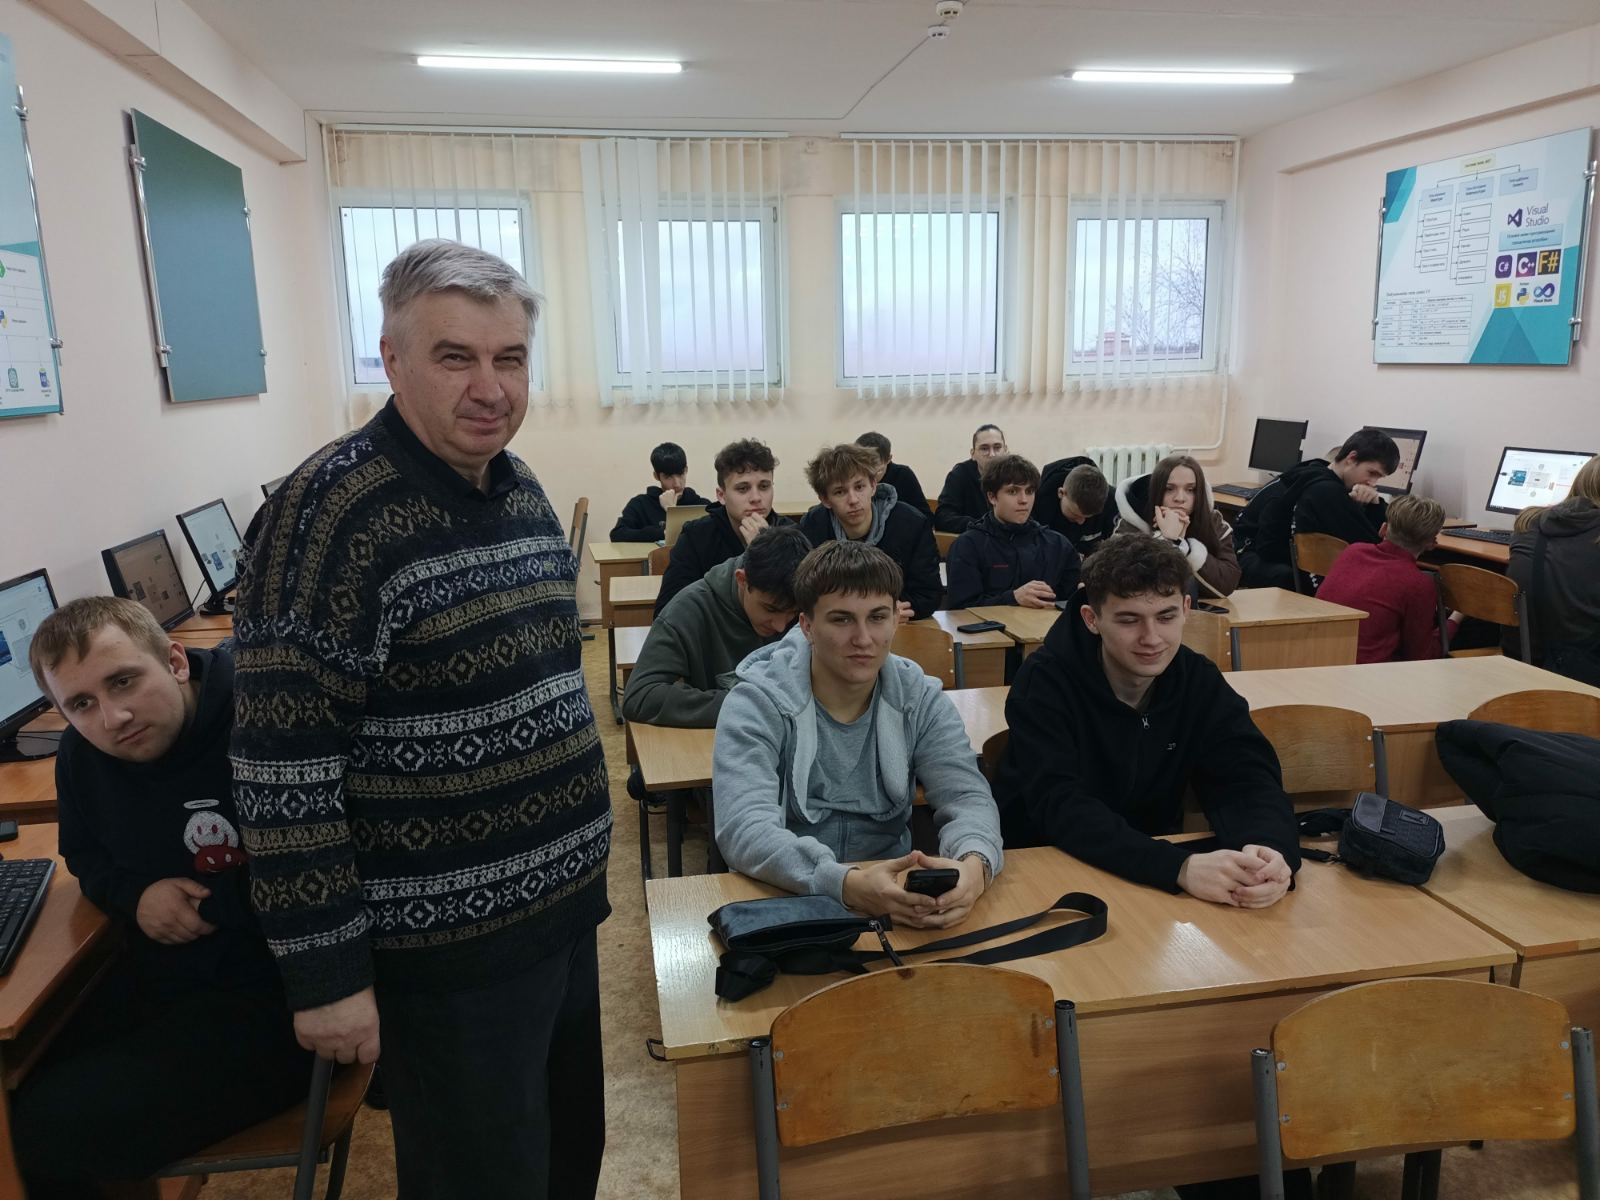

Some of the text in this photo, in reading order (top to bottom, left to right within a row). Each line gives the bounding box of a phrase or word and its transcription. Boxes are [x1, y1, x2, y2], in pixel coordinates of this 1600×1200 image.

[1526, 202, 1549, 216] Visual
[1525, 217, 1550, 227] Studio
[1498, 262, 1509, 272] C#
[1518, 256, 1535, 274] C++
[1538, 251, 1559, 273] F#
